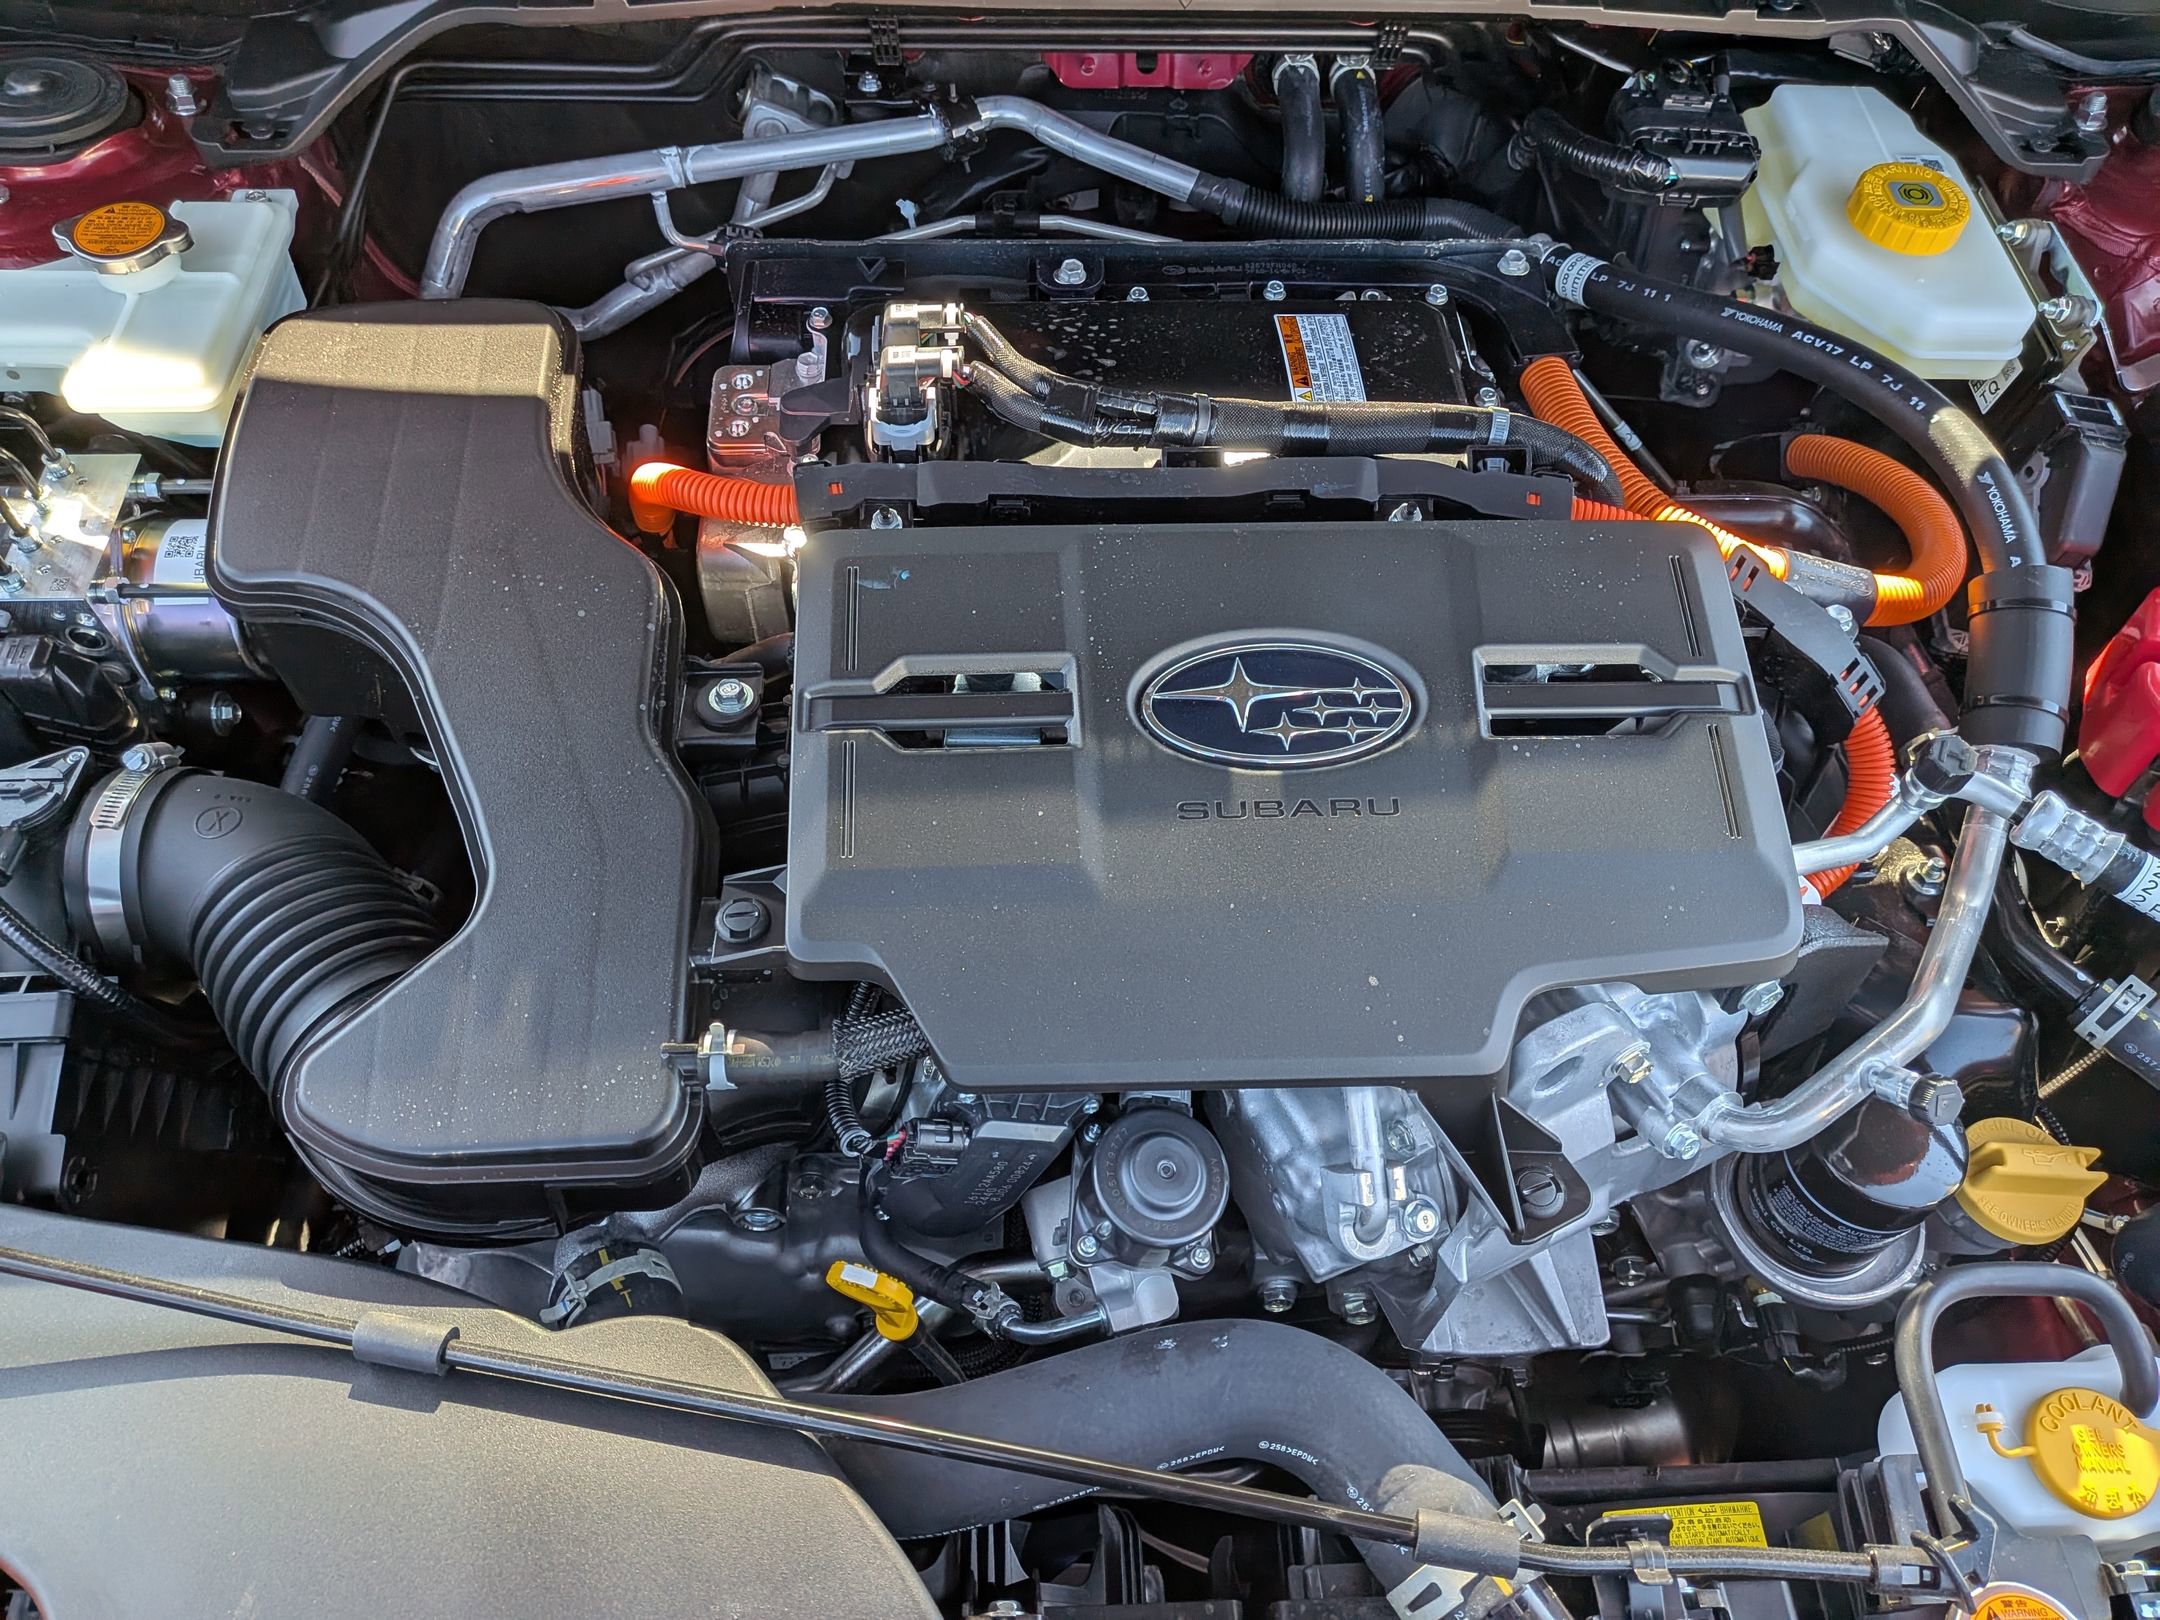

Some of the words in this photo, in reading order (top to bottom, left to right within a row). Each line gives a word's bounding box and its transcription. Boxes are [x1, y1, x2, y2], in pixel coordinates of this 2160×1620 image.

[1590, 272, 1609, 282] LP
[1734, 310, 1784, 334] YOKOHAMA
[1791, 330, 1845, 355] ACV17
[1849, 355, 1873, 371] LP
[1881, 374, 1904, 392] 7J
[1986, 485, 2017, 544] YOKOHAMA
[1175, 797, 1401, 820] SUBARU
[1979, 1195, 1999, 1215] SEE
[2048, 1202, 2080, 1230] MANUAL
[1837, 1225, 1883, 1239] CAUTION
[2040, 1392, 2138, 1433] COOLANT
[2001, 1607, 2049, 1617] WARNING
